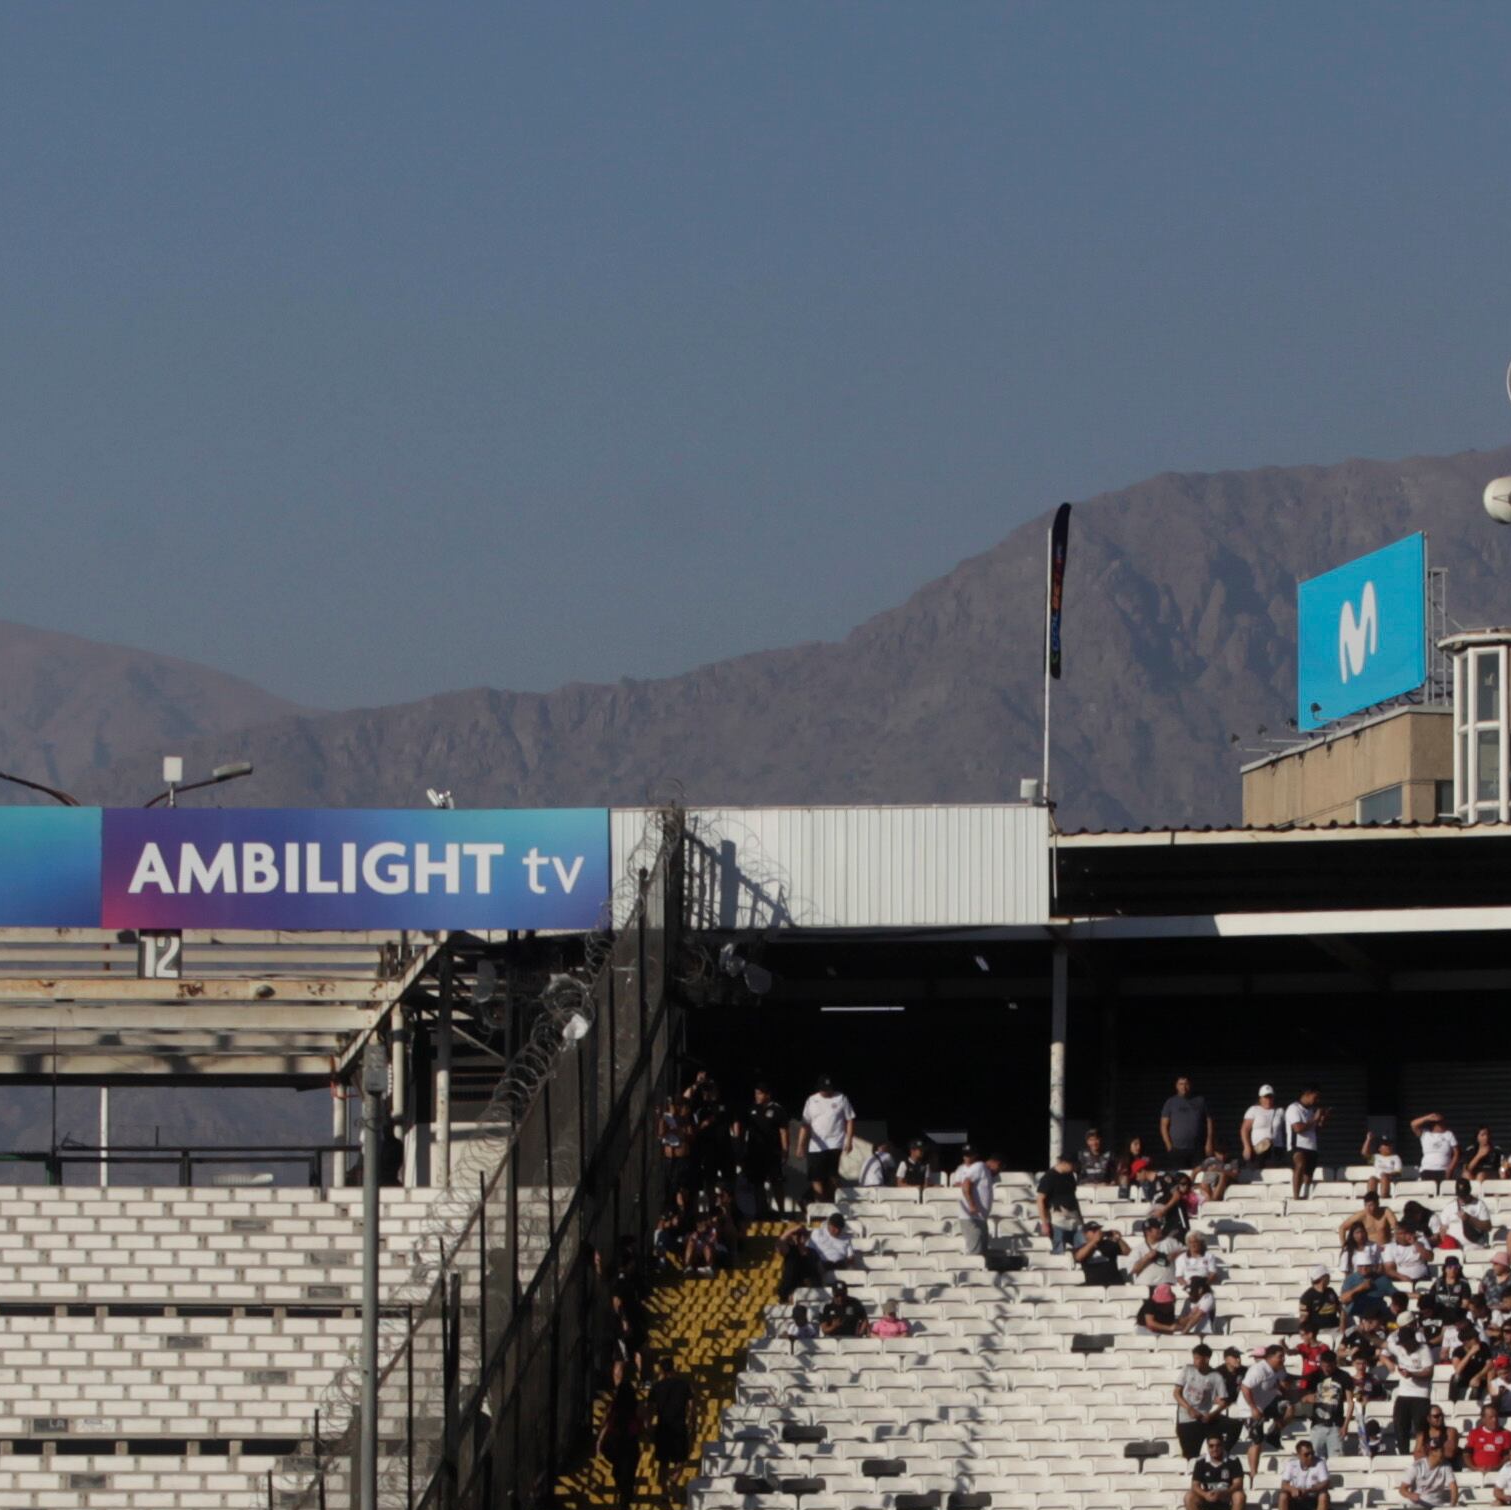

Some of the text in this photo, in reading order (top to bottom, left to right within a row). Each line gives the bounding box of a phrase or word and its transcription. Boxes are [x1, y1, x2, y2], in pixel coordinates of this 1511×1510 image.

[129, 842, 585, 895] AMBILIGHT tv
[140, 936, 180, 978] 12
